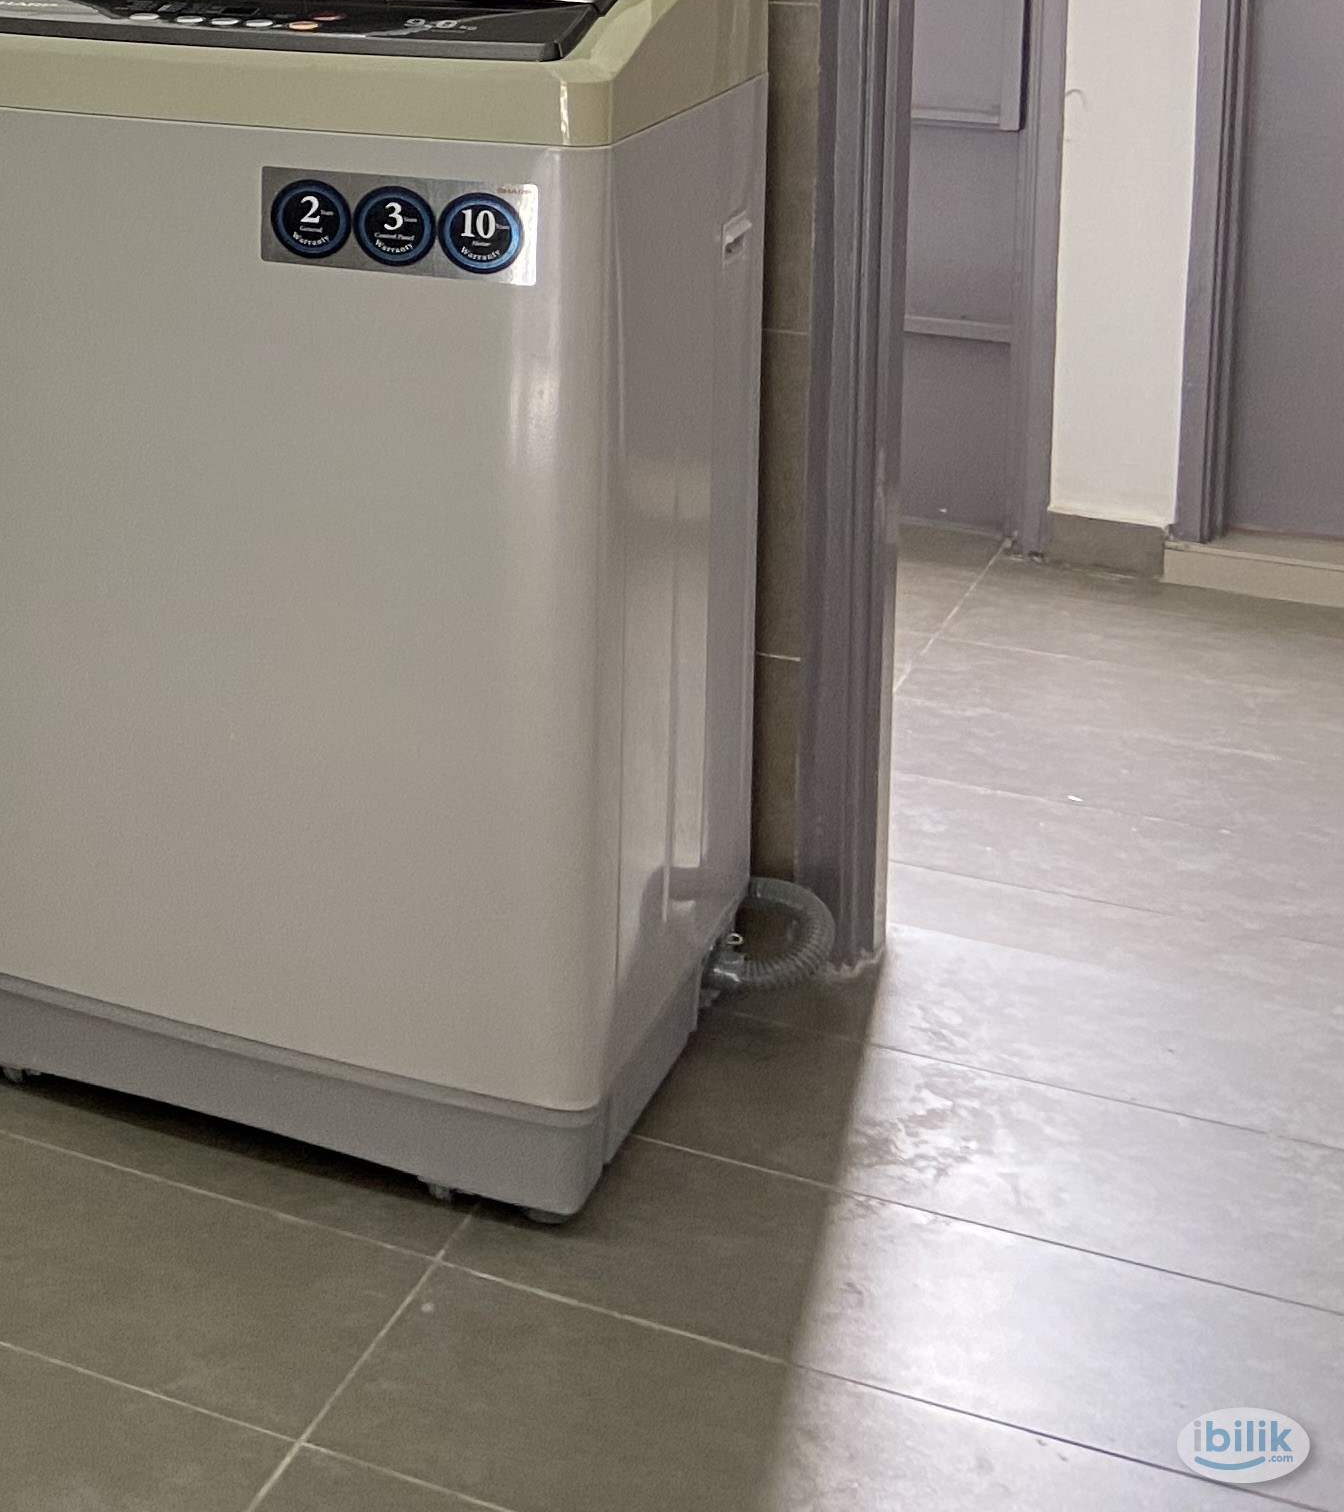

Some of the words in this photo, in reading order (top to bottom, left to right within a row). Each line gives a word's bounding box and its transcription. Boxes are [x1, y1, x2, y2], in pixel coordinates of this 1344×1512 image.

[300, 195, 321, 224] 2
[383, 201, 404, 231] 3
[460, 208, 497, 239] 10
[292, 231, 330, 246] Warranty
[375, 238, 414, 254] Warranty
[460, 245, 501, 261] Warranty
